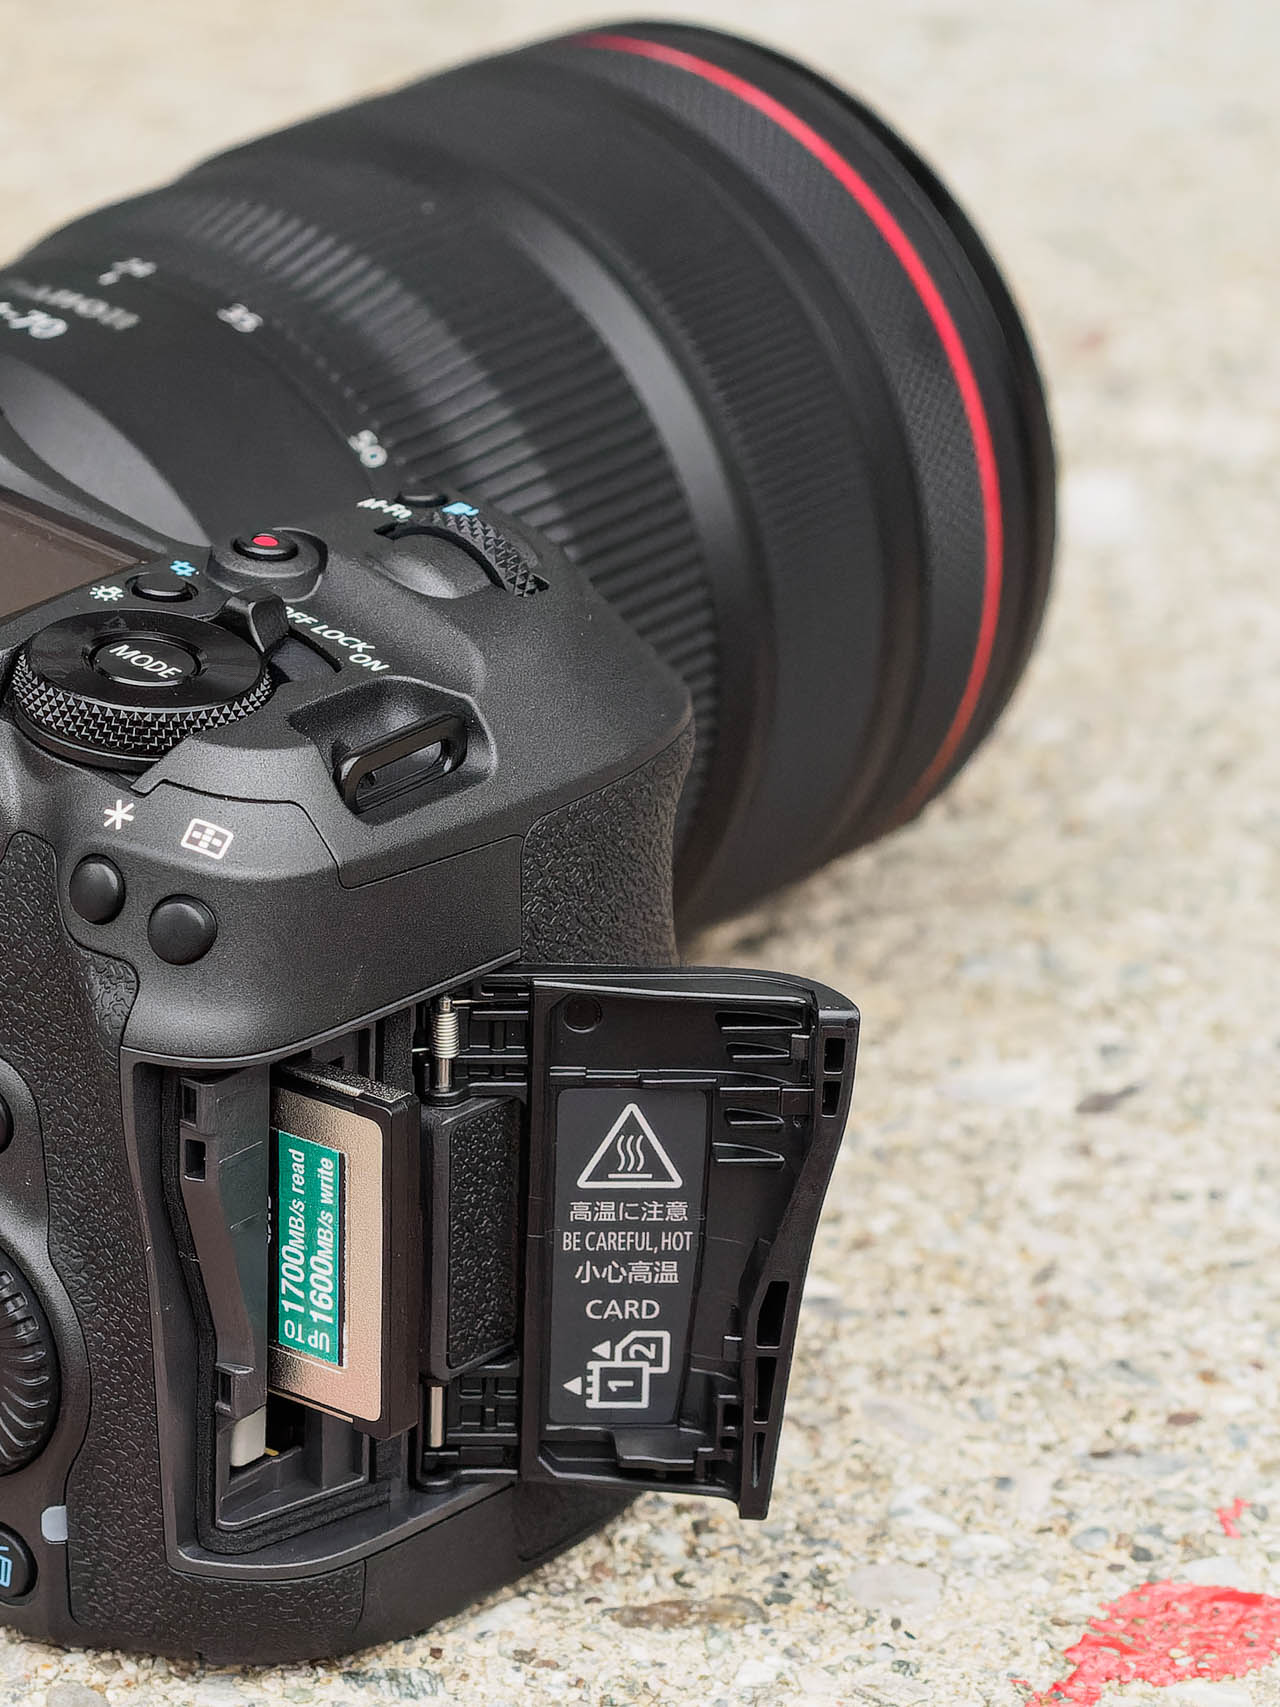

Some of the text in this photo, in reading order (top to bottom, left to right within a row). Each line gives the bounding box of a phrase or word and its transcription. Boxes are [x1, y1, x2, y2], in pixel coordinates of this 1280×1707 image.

[311, 625, 375, 652] LOCK
[109, 644, 182, 678] MODE
[349, 653, 389, 671] ON
[569, 1200, 689, 1222] 高温に注意
[281, 1148, 305, 1313] 1700MB/s read
[310, 1157, 334, 1324] 1600MB/s write
[562, 1231, 693, 1254] BE CAREFUL, HOT
[574, 1260, 680, 1285] 小心高温
[585, 1299, 660, 1320] CARD
[284, 1319, 330, 1353] UP TO
[629, 1342, 657, 1360] 2
[607, 1379, 634, 1392] 1
